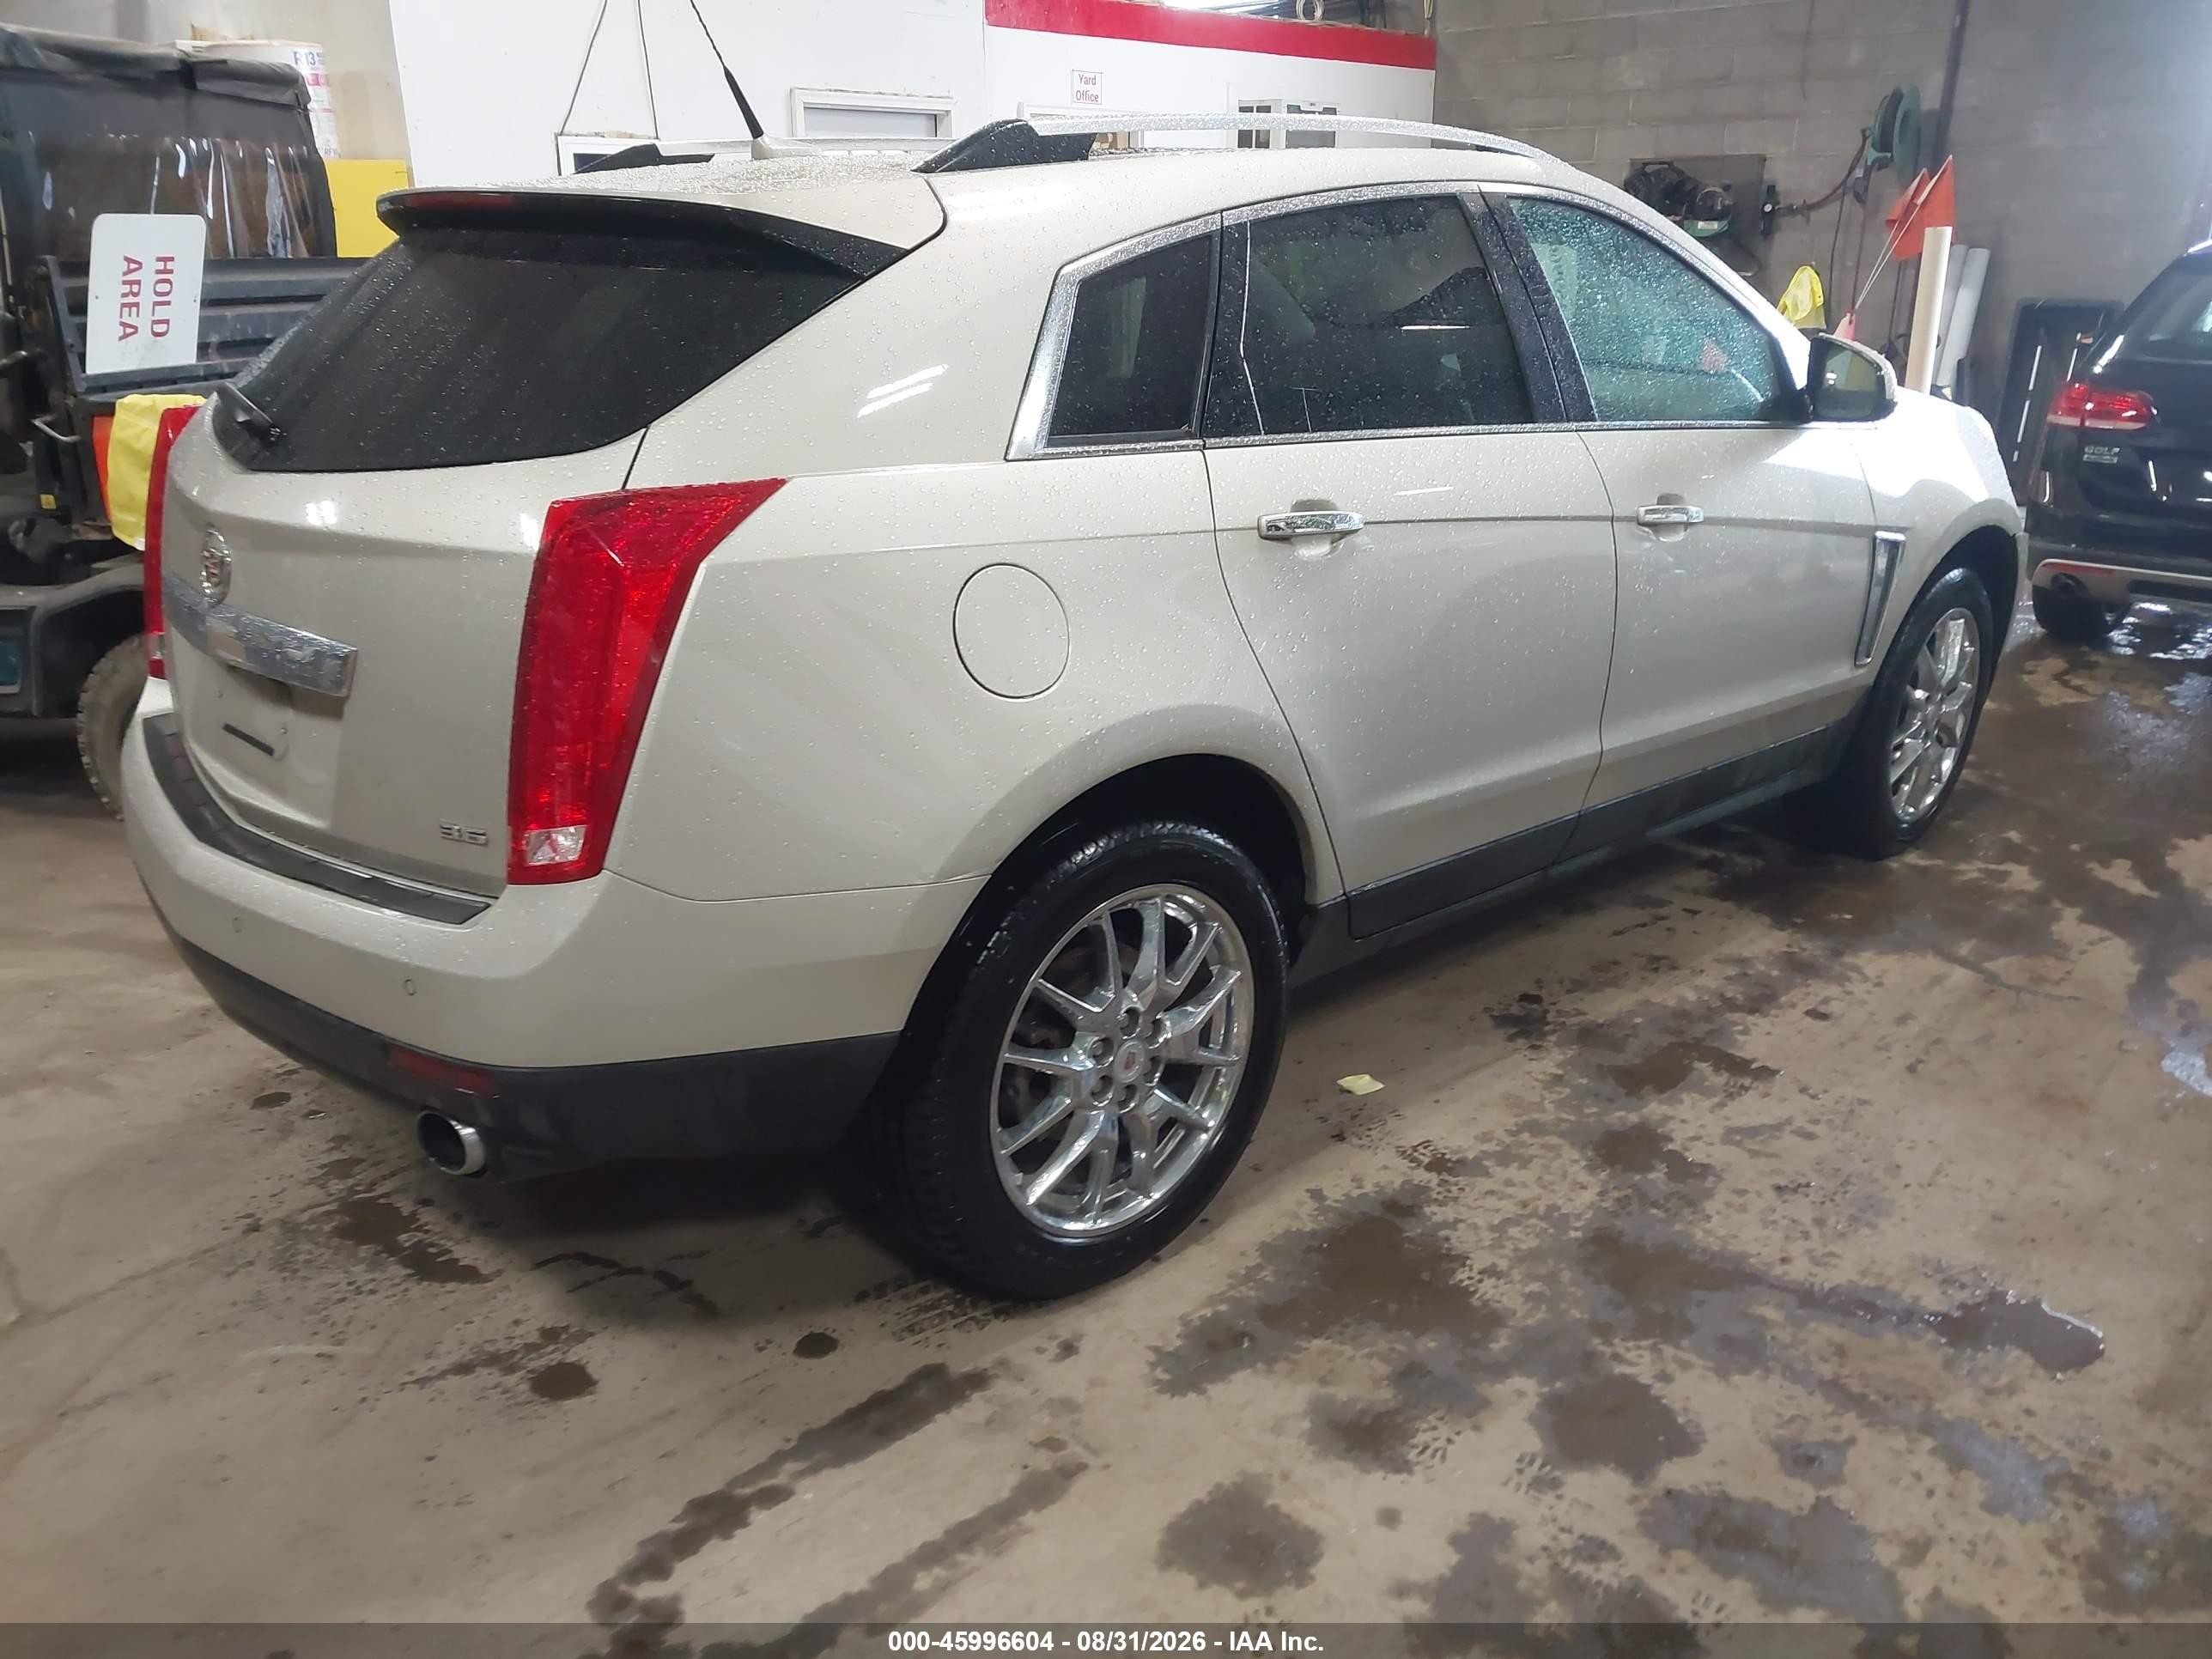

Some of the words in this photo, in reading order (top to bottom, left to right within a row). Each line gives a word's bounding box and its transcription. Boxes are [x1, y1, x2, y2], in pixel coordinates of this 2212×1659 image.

[1079, 74, 1097, 86] Yard
[1076, 89, 1099, 102] Office
[118, 255, 143, 342] AREA
[150, 256, 175, 338] HOLD
[2084, 446, 2121, 455] GOLF
